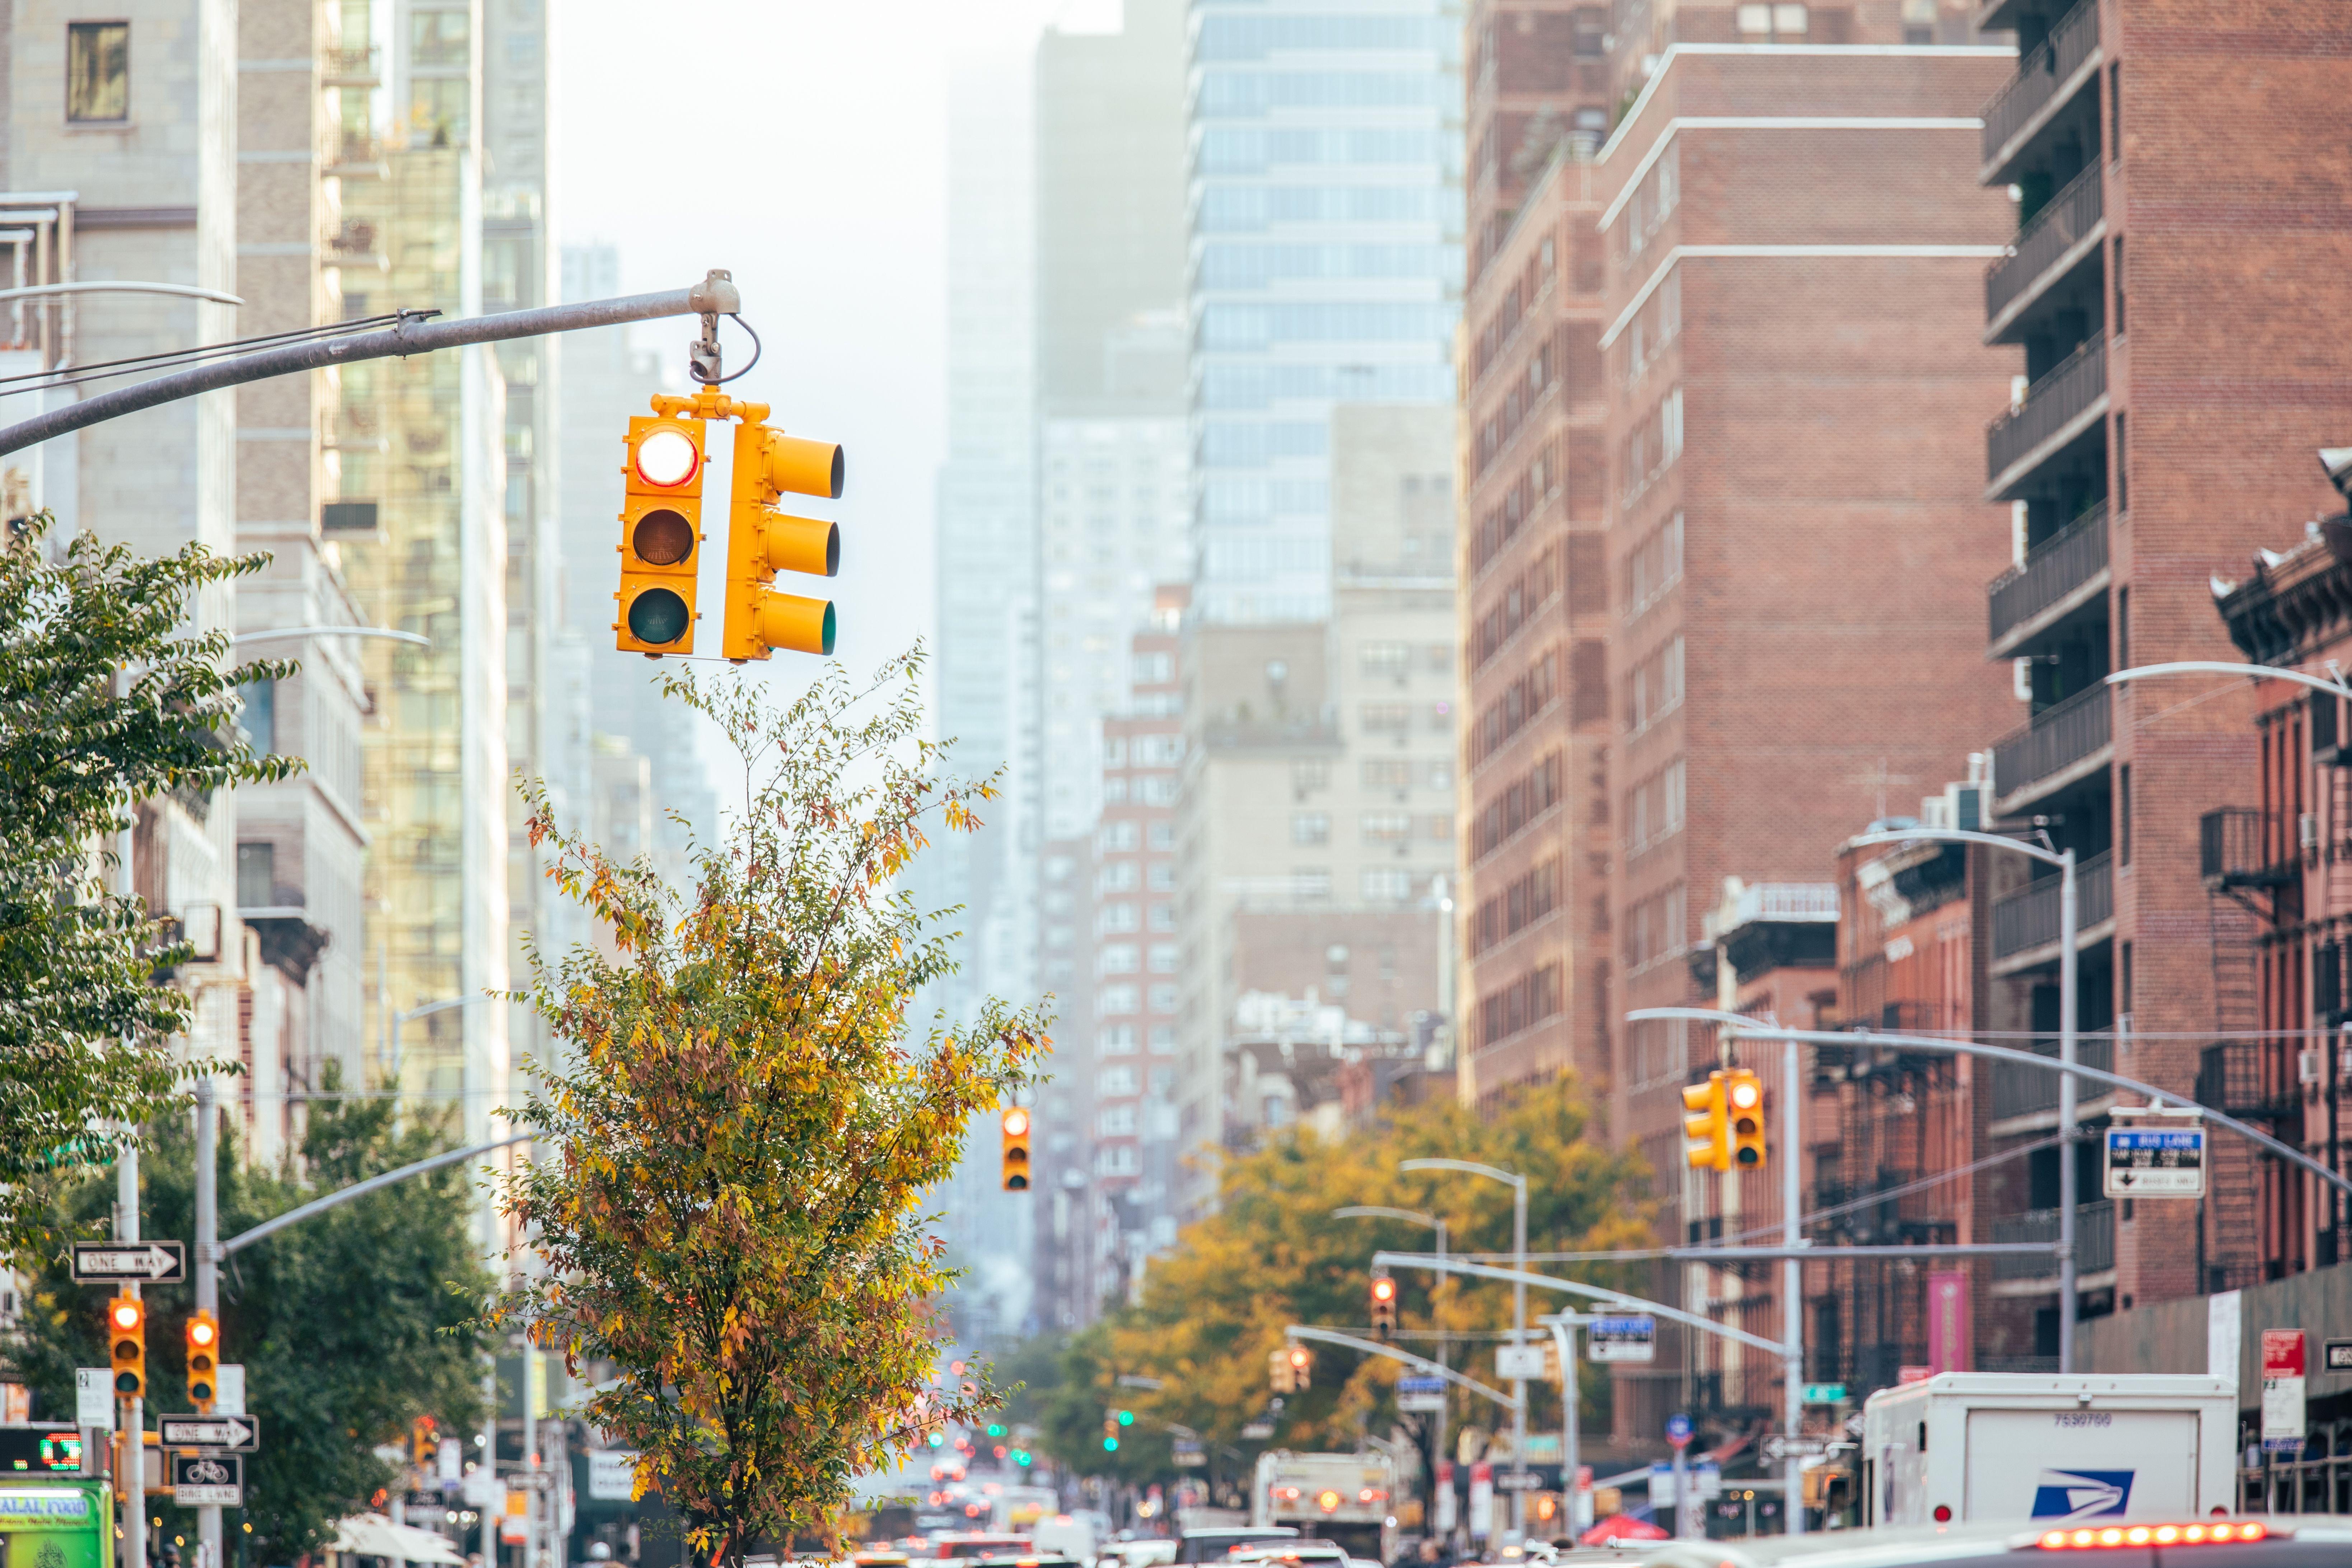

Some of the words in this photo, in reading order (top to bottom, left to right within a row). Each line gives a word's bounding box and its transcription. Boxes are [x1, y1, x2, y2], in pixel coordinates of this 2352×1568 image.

[88, 1253, 118, 1271] ONE
[134, 1253, 164, 1271] WAY
[2338, 1348, 2352, 1365] ON
[174, 1424, 200, 1442] ONE
[214, 1424, 239, 1442] WAY
[180, 1486, 201, 1502] BIKE
[209, 1486, 235, 1502] LANE
[0, 1500, 43, 1513] ALAL
[47, 1500, 86, 1513] FOOD
